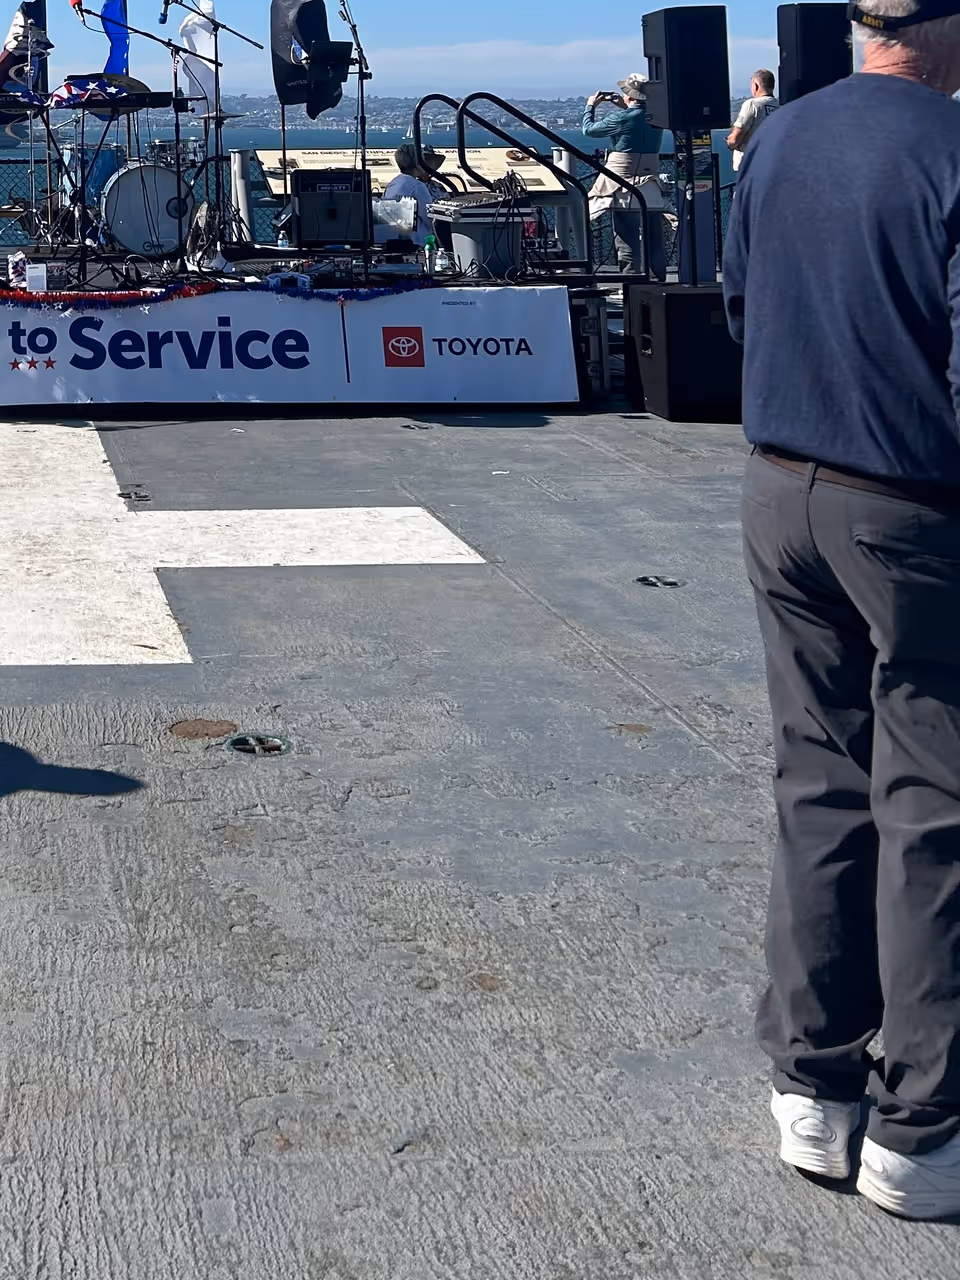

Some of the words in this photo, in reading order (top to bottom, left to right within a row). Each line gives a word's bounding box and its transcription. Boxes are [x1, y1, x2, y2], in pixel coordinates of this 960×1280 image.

[861, 14, 884, 28] ARMY
[8, 321, 57, 355] to
[69, 316, 311, 370] Service
[432, 337, 533, 356] TOYOTA
